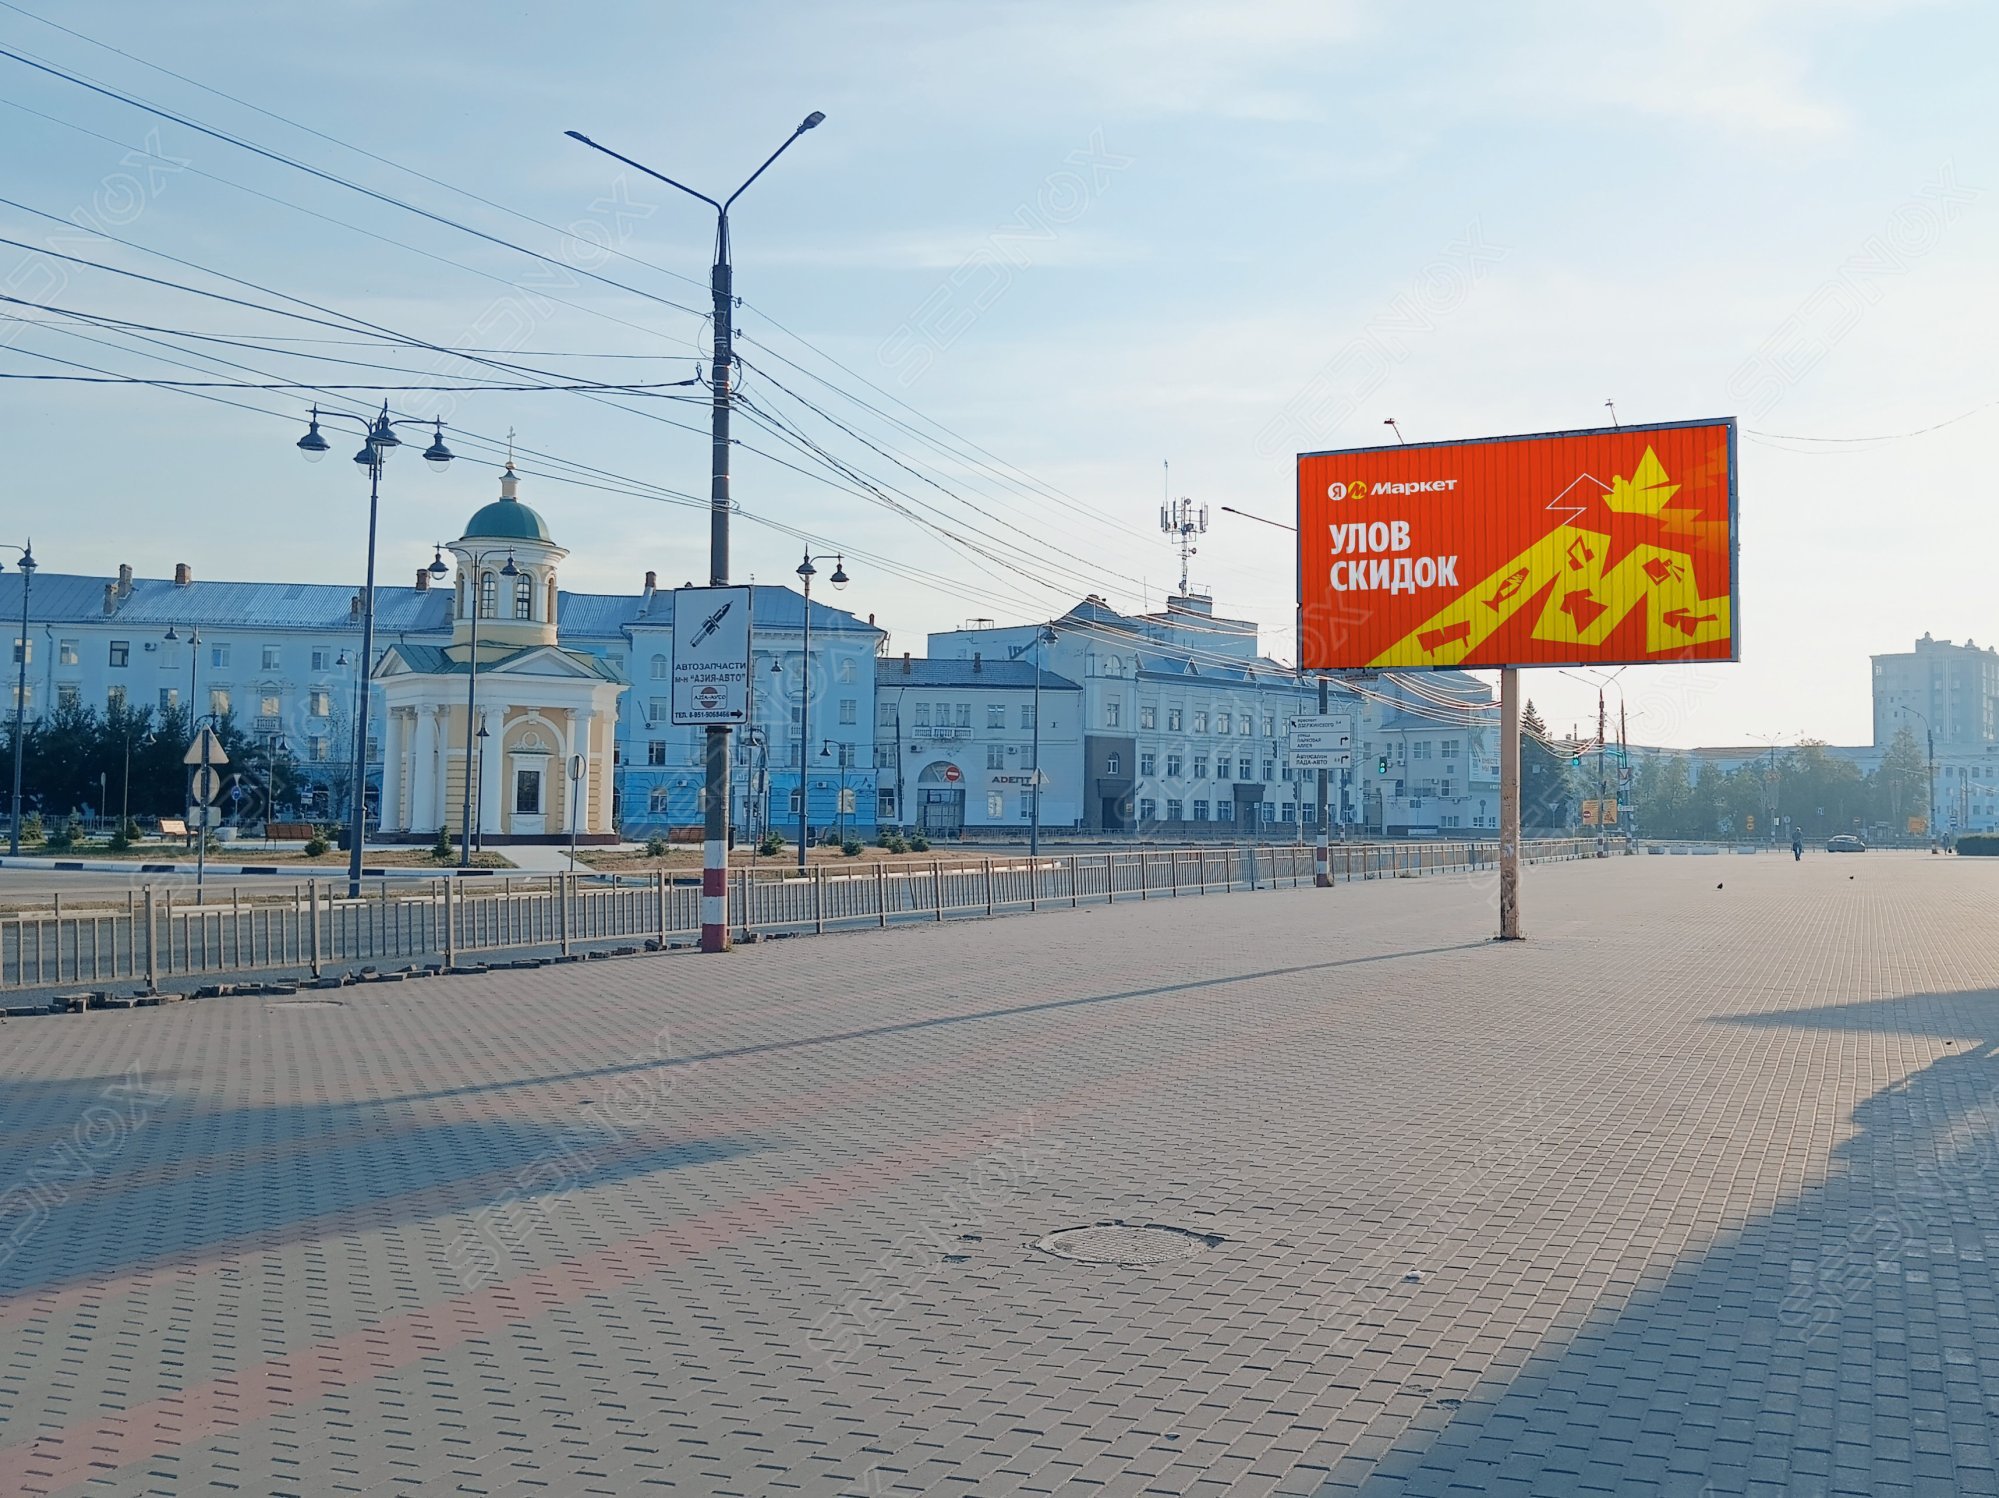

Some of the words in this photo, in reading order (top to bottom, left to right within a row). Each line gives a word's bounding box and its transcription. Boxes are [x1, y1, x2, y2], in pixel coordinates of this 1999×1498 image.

[1370, 480, 1457, 496] Маркет
[1328, 520, 1411, 555] УЛОВ
[1329, 555, 1459, 595] СКИДОК
[675, 662, 746, 671] АВТОЗАПЧАСТИ
